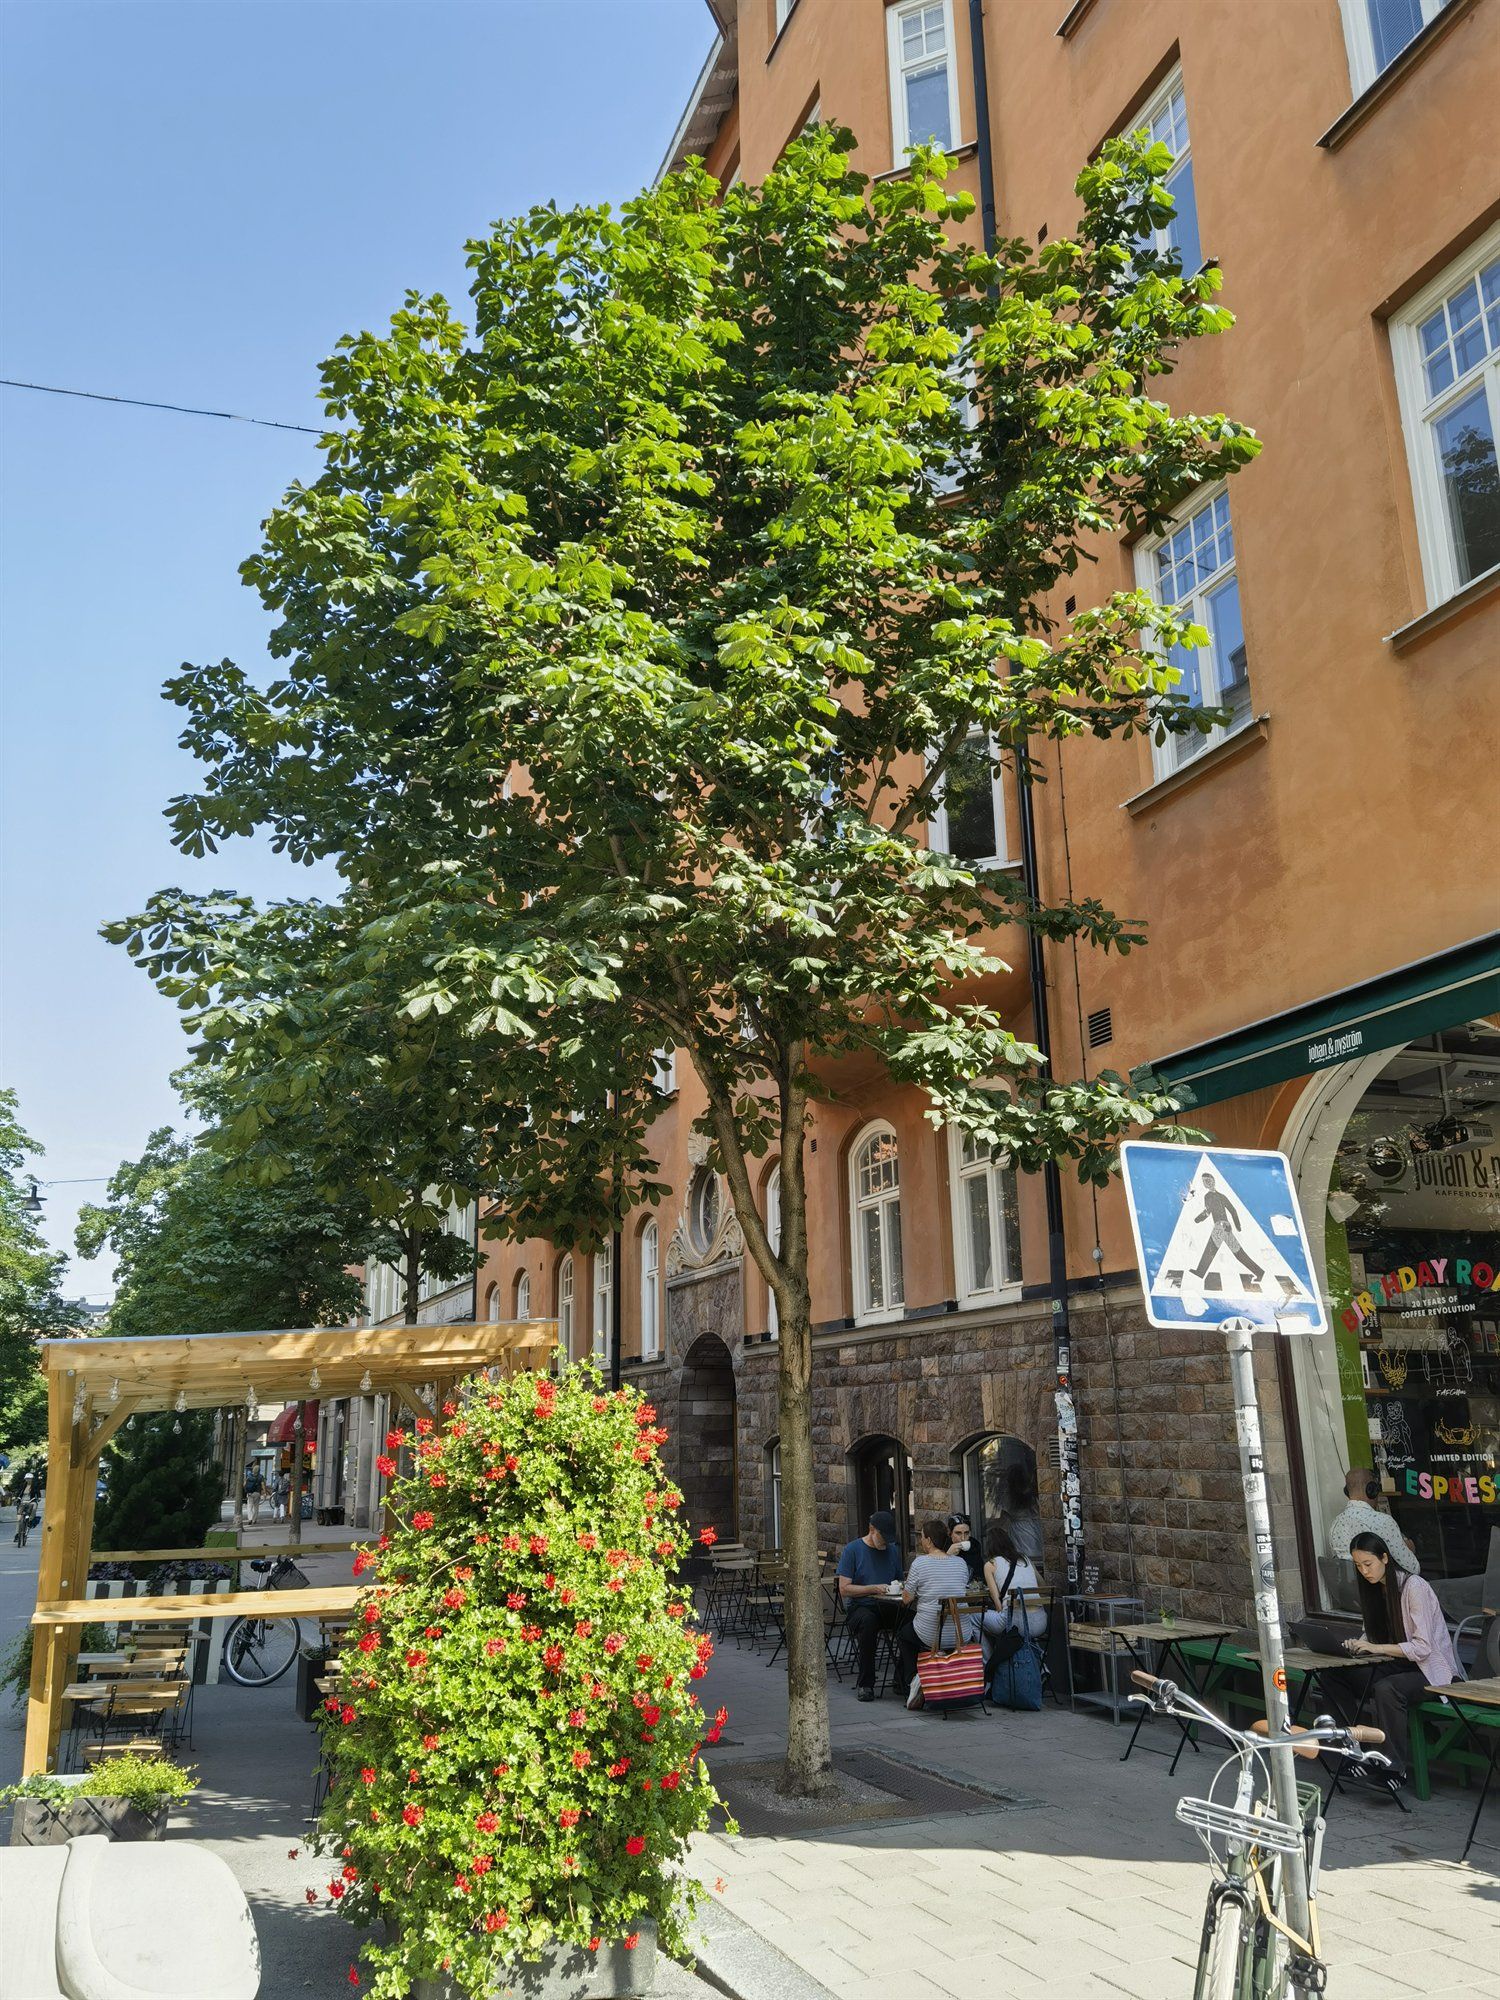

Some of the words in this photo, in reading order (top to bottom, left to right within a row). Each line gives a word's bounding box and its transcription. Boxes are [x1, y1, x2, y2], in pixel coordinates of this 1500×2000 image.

[1308, 1043, 1328, 1063] johan
[1328, 1037, 1334, 1055] &
[1334, 1030, 1363, 1055] nyström
[1341, 1258, 1448, 1334] BIRTHDAY
[1411, 1300, 1421, 1308] 20
[1422, 1296, 1446, 1306] YEARS
[1448, 1295, 1458, 1304] OF
[1400, 1309, 1426, 1319] COFFEE
[1427, 1303, 1476, 1316] REVOLUTION
[1430, 1453, 1460, 1462] LIMITED
[1462, 1453, 1494, 1462] EDITION
